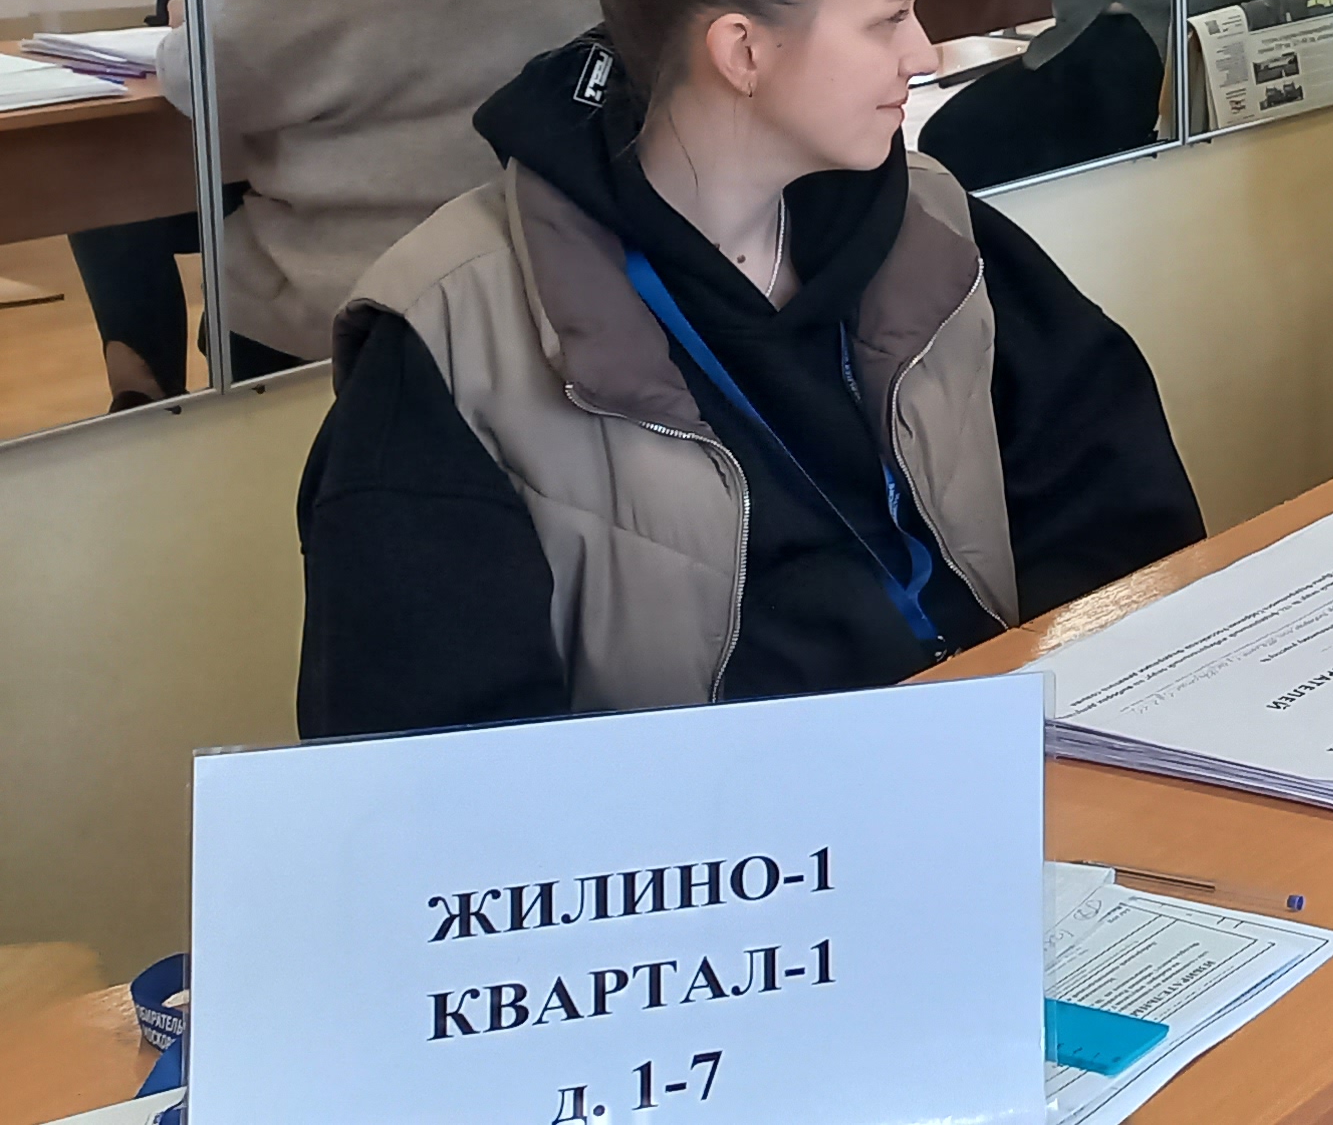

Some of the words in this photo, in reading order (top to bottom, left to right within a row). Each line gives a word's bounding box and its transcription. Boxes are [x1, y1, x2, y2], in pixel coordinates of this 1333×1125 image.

[428, 847, 833, 944] ЖИЛИНО-1
[428, 938, 833, 1040] КВАРТАЛ-1
[552, 1086, 605, 1125] д.
[633, 1051, 722, 1110] 1-7
